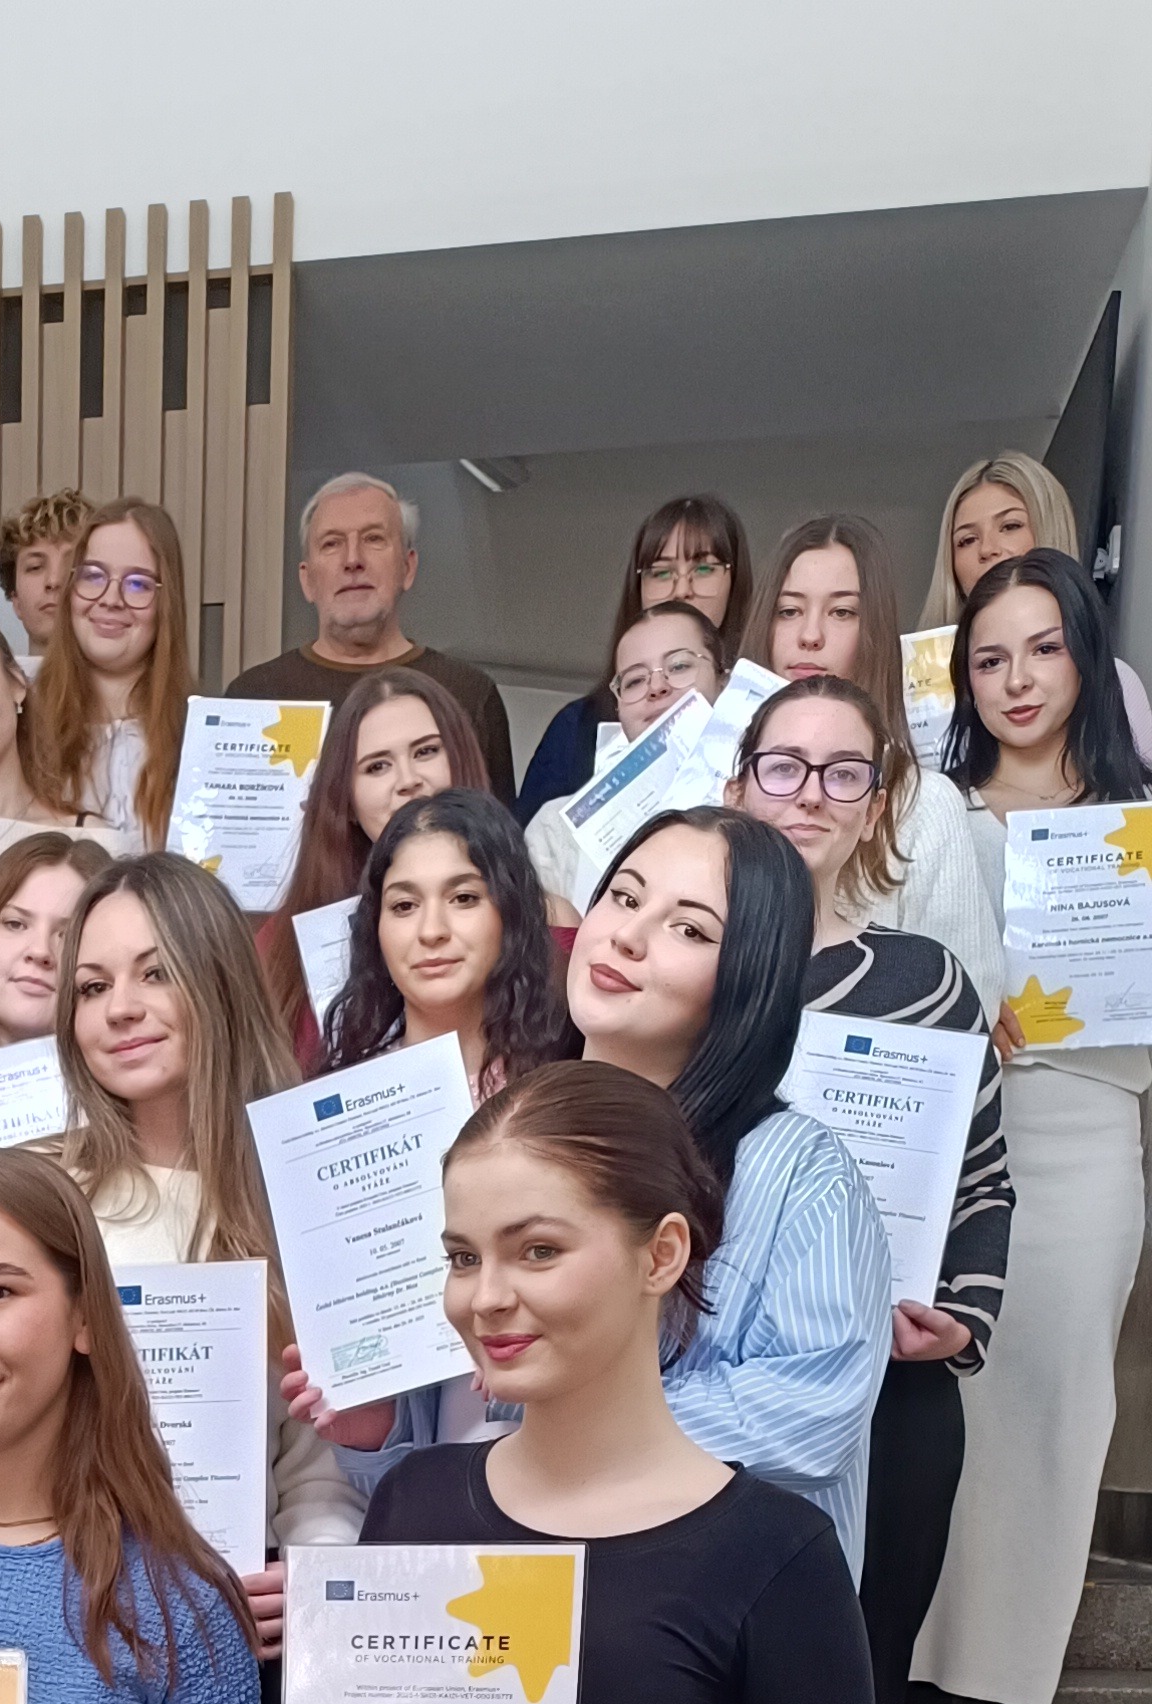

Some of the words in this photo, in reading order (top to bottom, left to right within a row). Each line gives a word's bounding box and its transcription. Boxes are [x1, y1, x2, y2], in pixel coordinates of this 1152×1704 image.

[215, 743, 291, 753] CERTIFICATE
[205, 782, 236, 790] TAMARA
[1050, 831, 1088, 840] Erasmus+
[1047, 851, 1143, 867] CERTIFICATE
[1050, 903, 1074, 912] NINA
[1078, 897, 1130, 910] BAJUSOVÁ
[872, 1047, 928, 1063] Erasmus+
[345, 1084, 405, 1112] Erasmus+
[823, 1088, 924, 1113] CERTIFIKÁT
[317, 1134, 423, 1181] CERTIFIKÁT
[344, 1159, 409, 1187] ABSOLVOVÁNÍ
[145, 1293, 206, 1306] Erasmus+
[139, 1342, 213, 1361] TIFIKÁT
[145, 1366, 194, 1374] OLVOVÁNÍ
[357, 1590, 419, 1602] Erasmus+
[351, 1635, 510, 1650] CERTIFICATE
[356, 1654, 369, 1662] OF
[374, 1654, 446, 1664] VOCATIONAL
[451, 1655, 504, 1664] TRAINING
